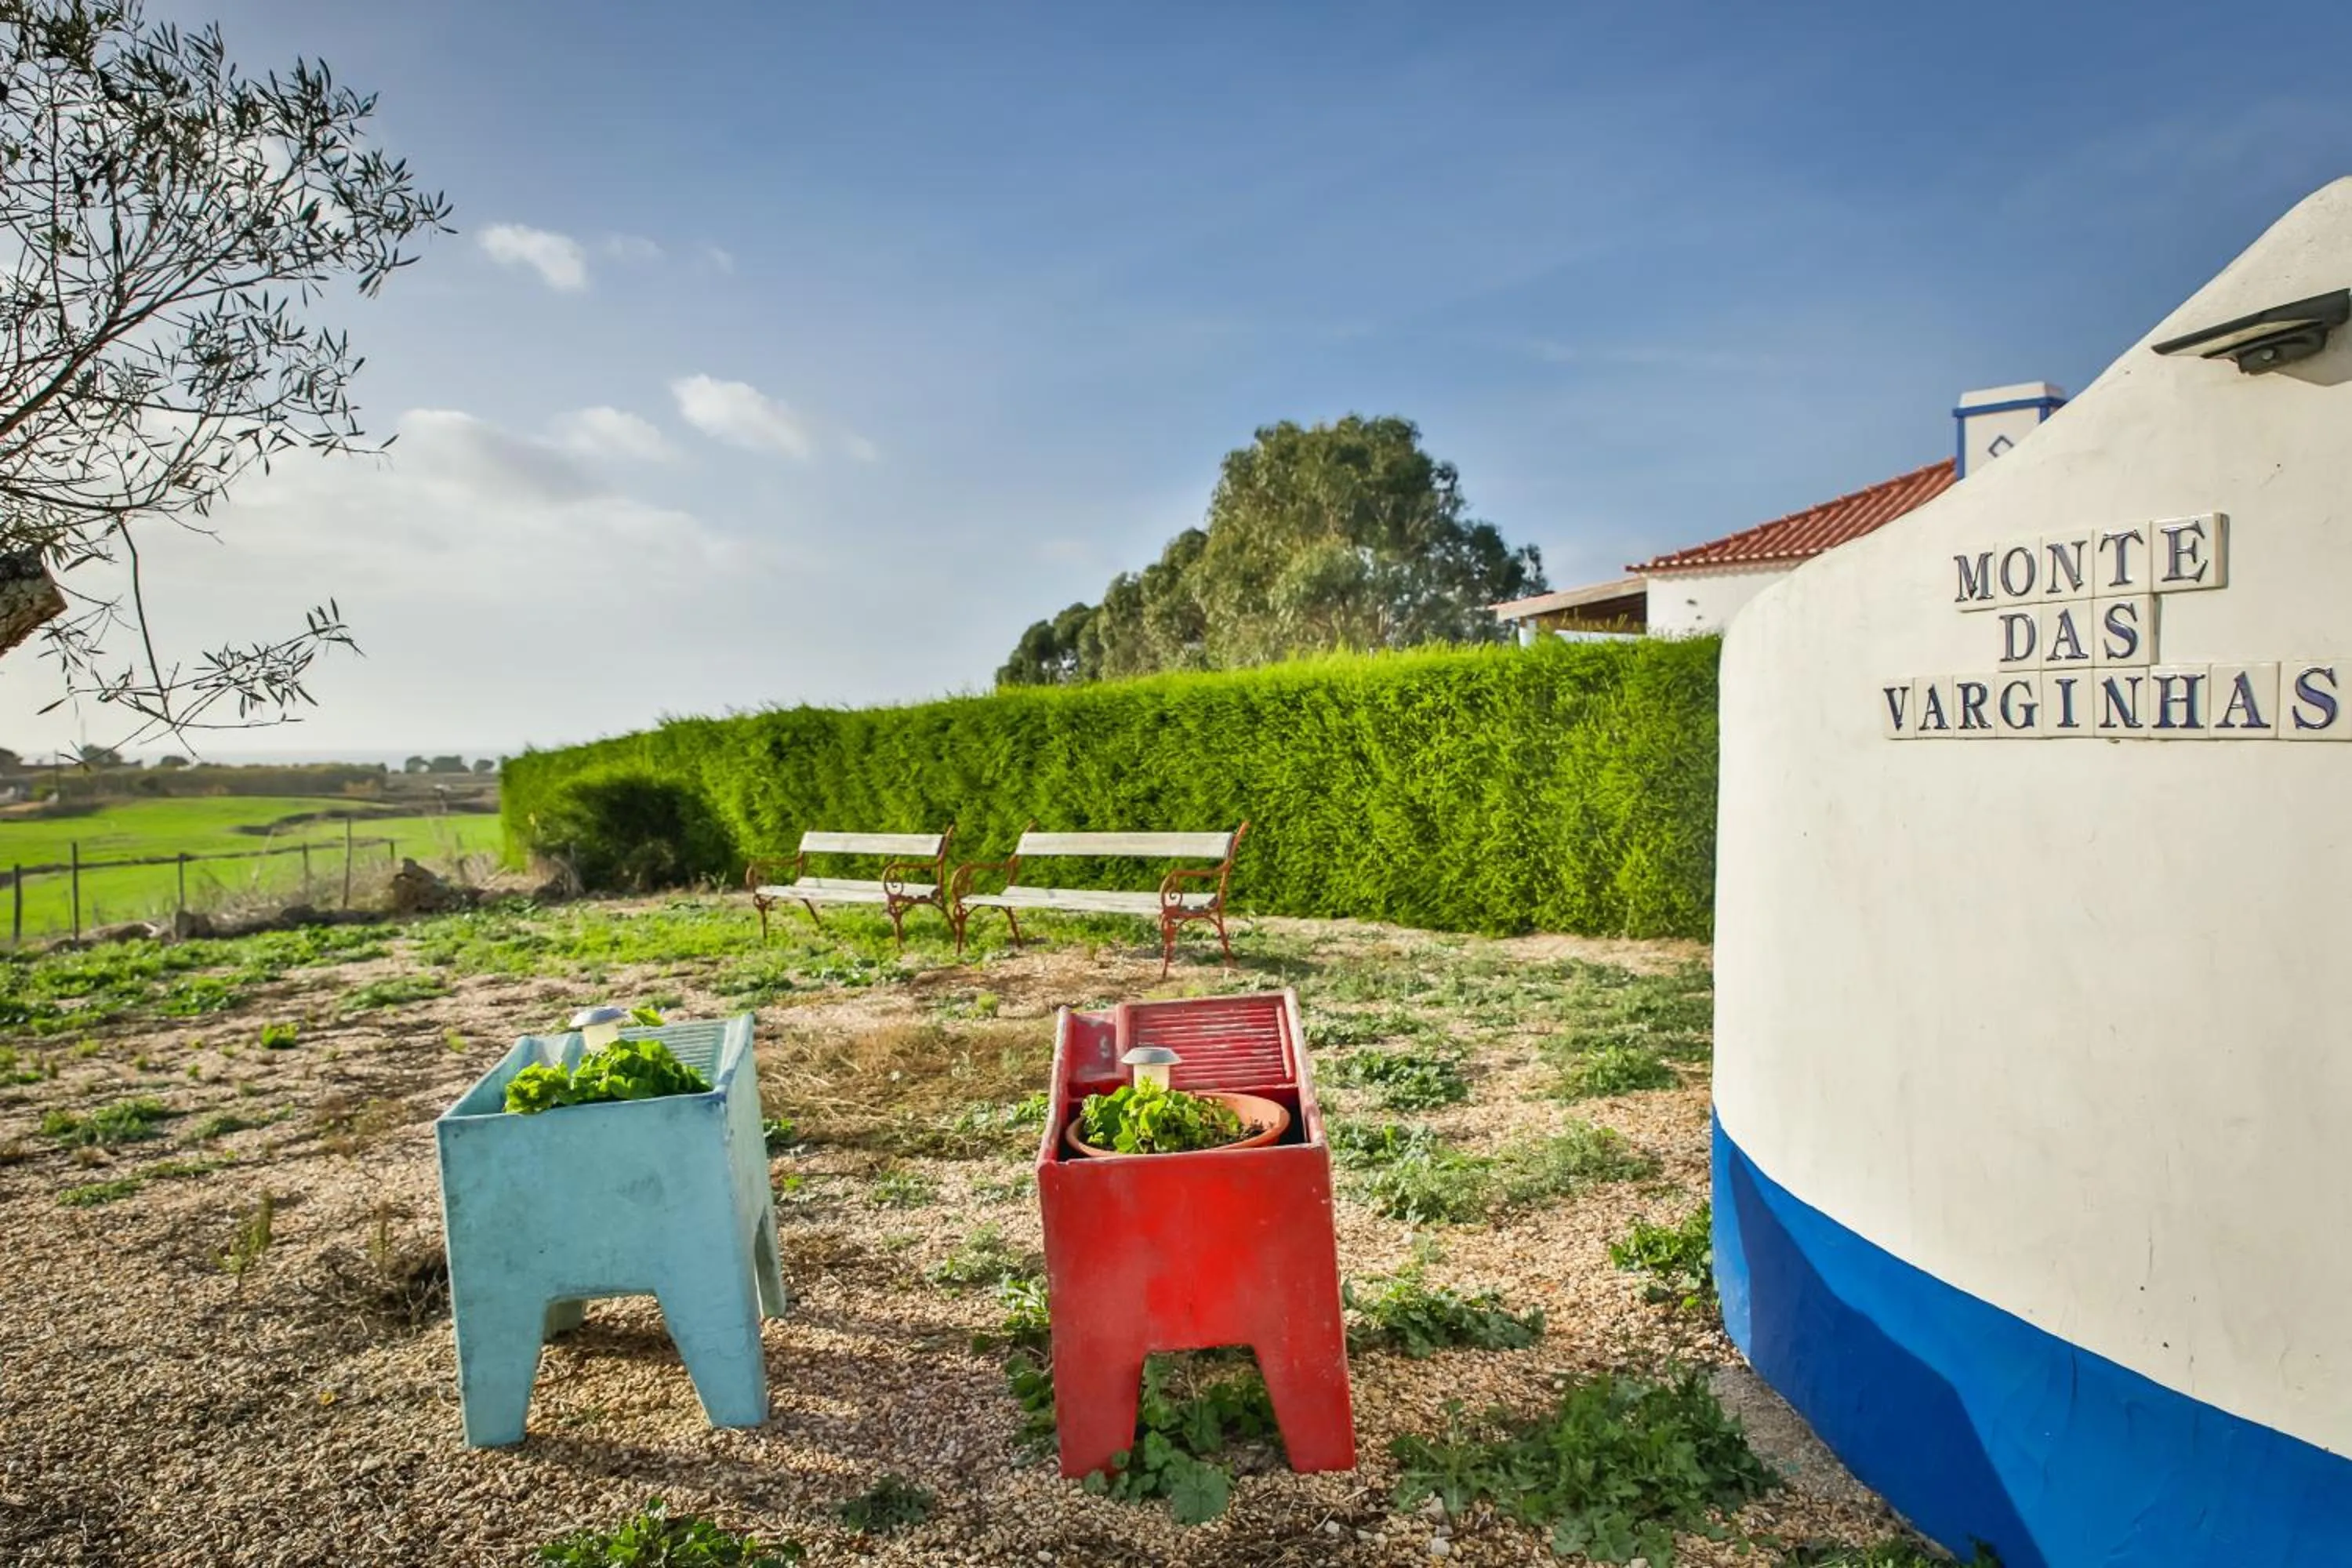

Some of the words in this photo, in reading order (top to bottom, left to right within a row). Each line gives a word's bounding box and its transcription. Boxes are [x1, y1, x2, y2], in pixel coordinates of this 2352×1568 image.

[1954, 520, 2209, 603] MONTE
[2000, 601, 2139, 662] DAS
[1883, 666, 2339, 731] VARGINHAS
